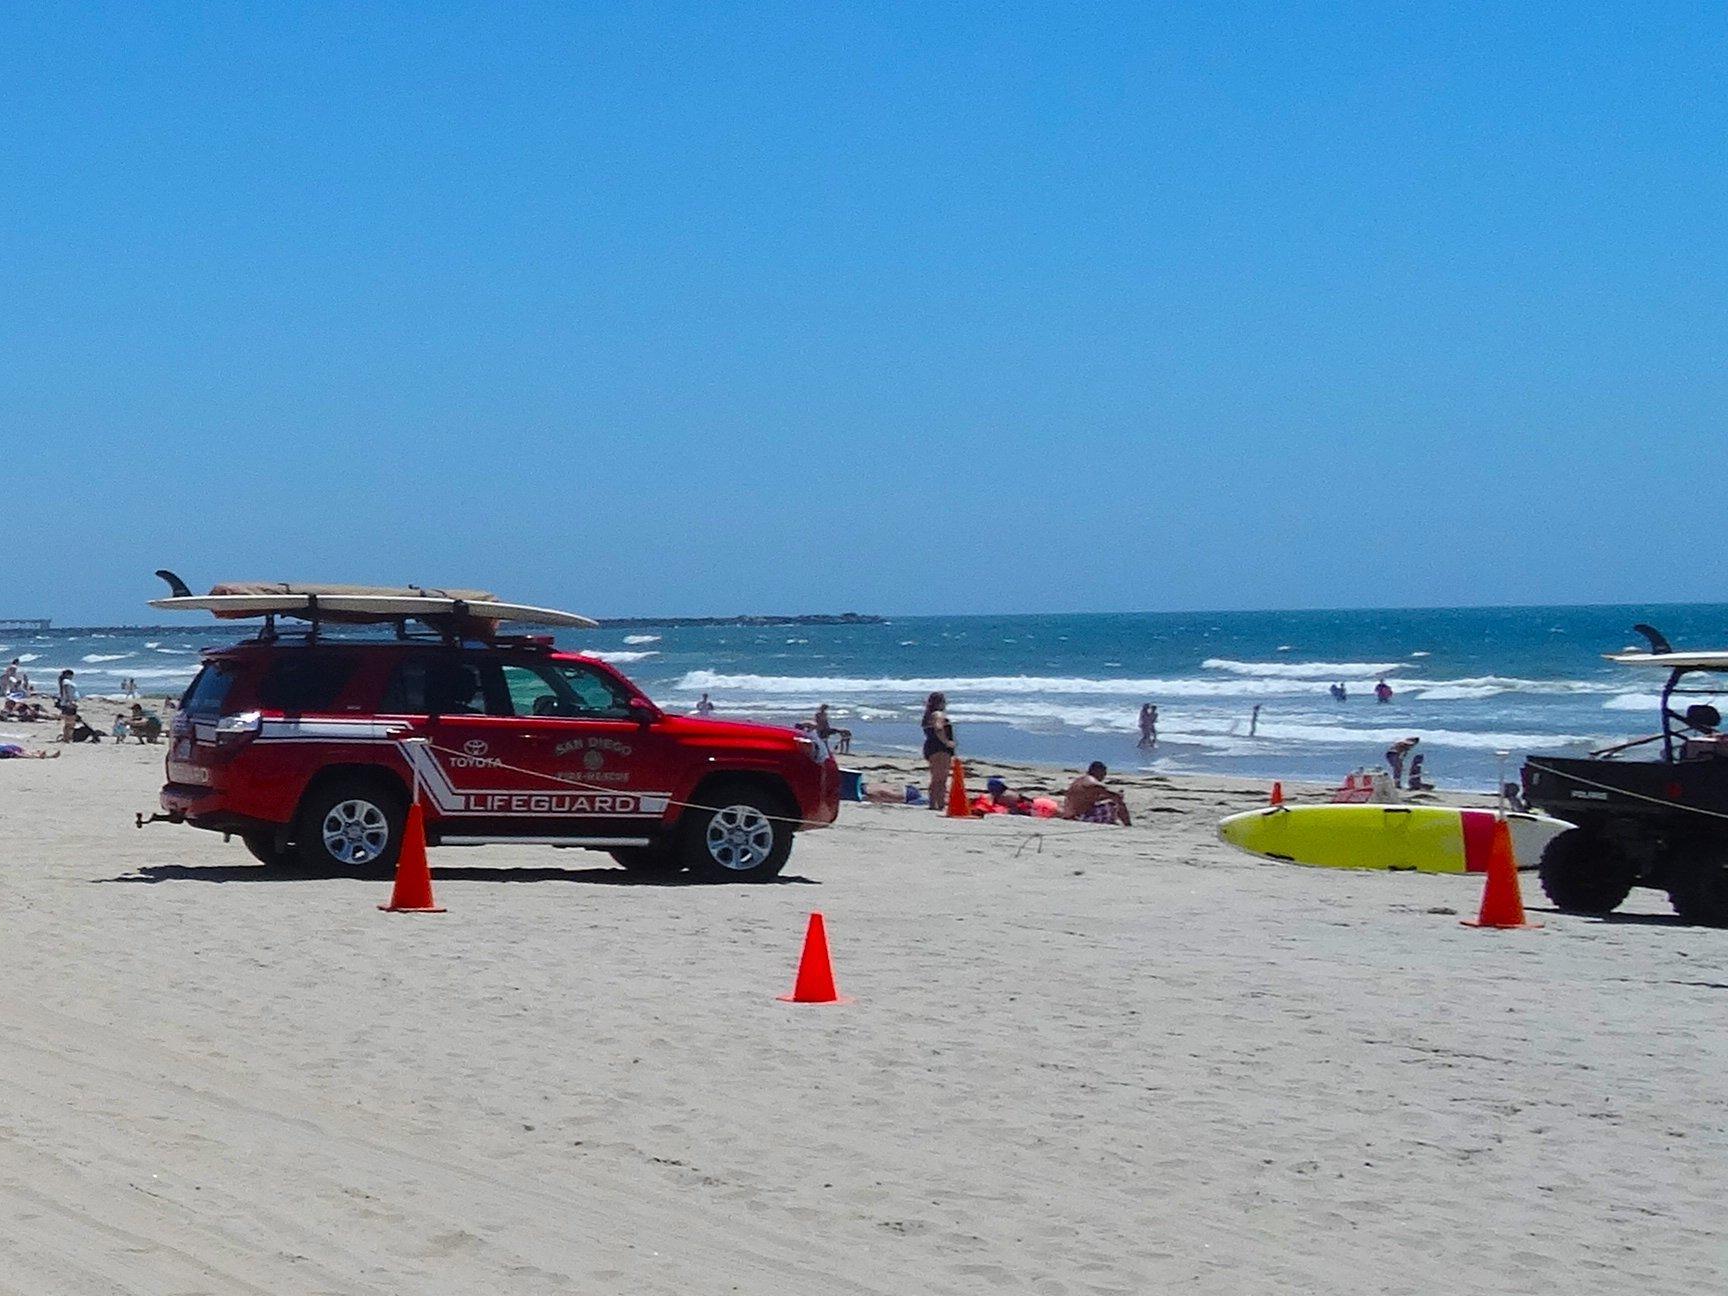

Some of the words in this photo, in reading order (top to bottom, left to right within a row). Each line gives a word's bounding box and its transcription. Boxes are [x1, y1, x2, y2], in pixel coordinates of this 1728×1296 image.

[554, 738, 584, 757] SAN
[587, 736, 633, 756] DIEGO
[448, 757, 503, 768] TOYOTA
[469, 795, 635, 812] LIFEGUARD
